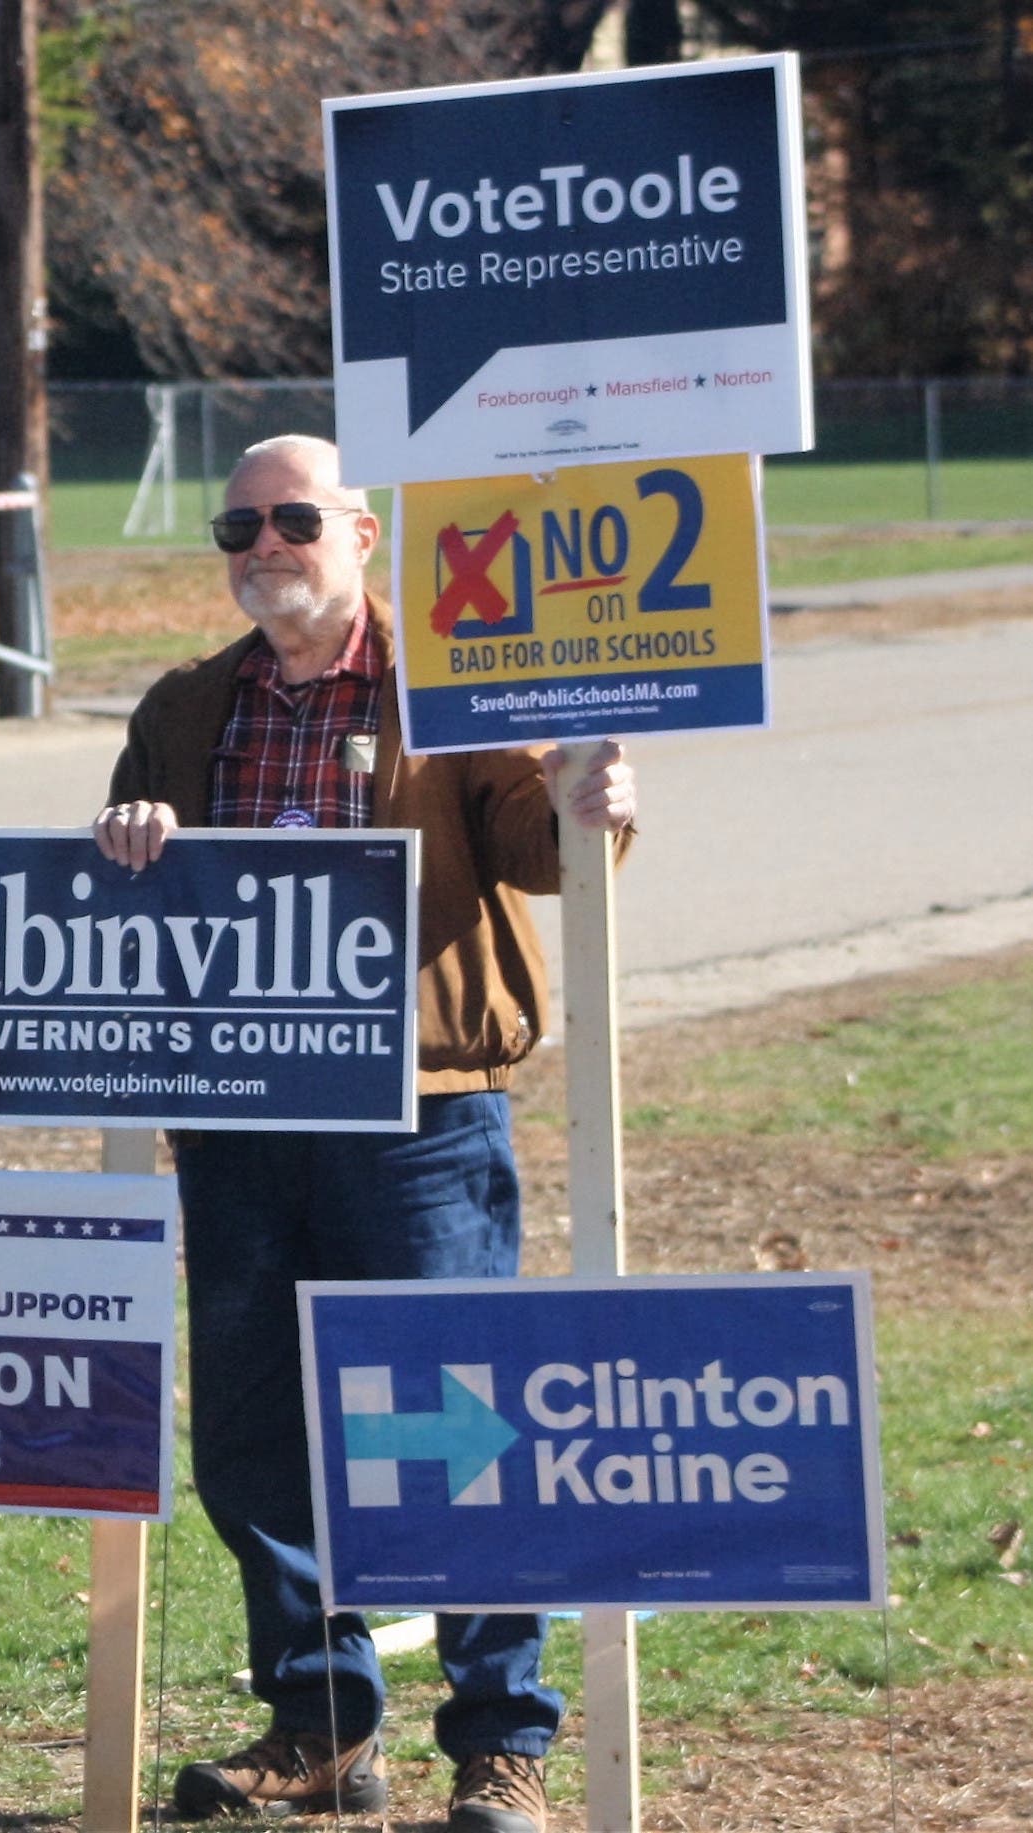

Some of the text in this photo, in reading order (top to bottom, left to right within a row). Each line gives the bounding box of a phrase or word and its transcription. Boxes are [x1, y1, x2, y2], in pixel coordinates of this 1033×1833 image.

[375, 154, 741, 243] VoteToole
[379, 233, 744, 294] State Representative
[477, 369, 773, 408] Foxborough Mansfield Norton
[542, 468, 712, 613] NO 2
[587, 592, 626, 624] on
[449, 628, 716, 674] BAD FOR OUR SCHOOLS
[470, 682, 698, 713] SaveOurPublicSchoolsMA.com
[210, 1022, 391, 1055] COUNCIL
[523, 1357, 850, 1431] Clinton
[534, 1434, 791, 1506] Kaine
